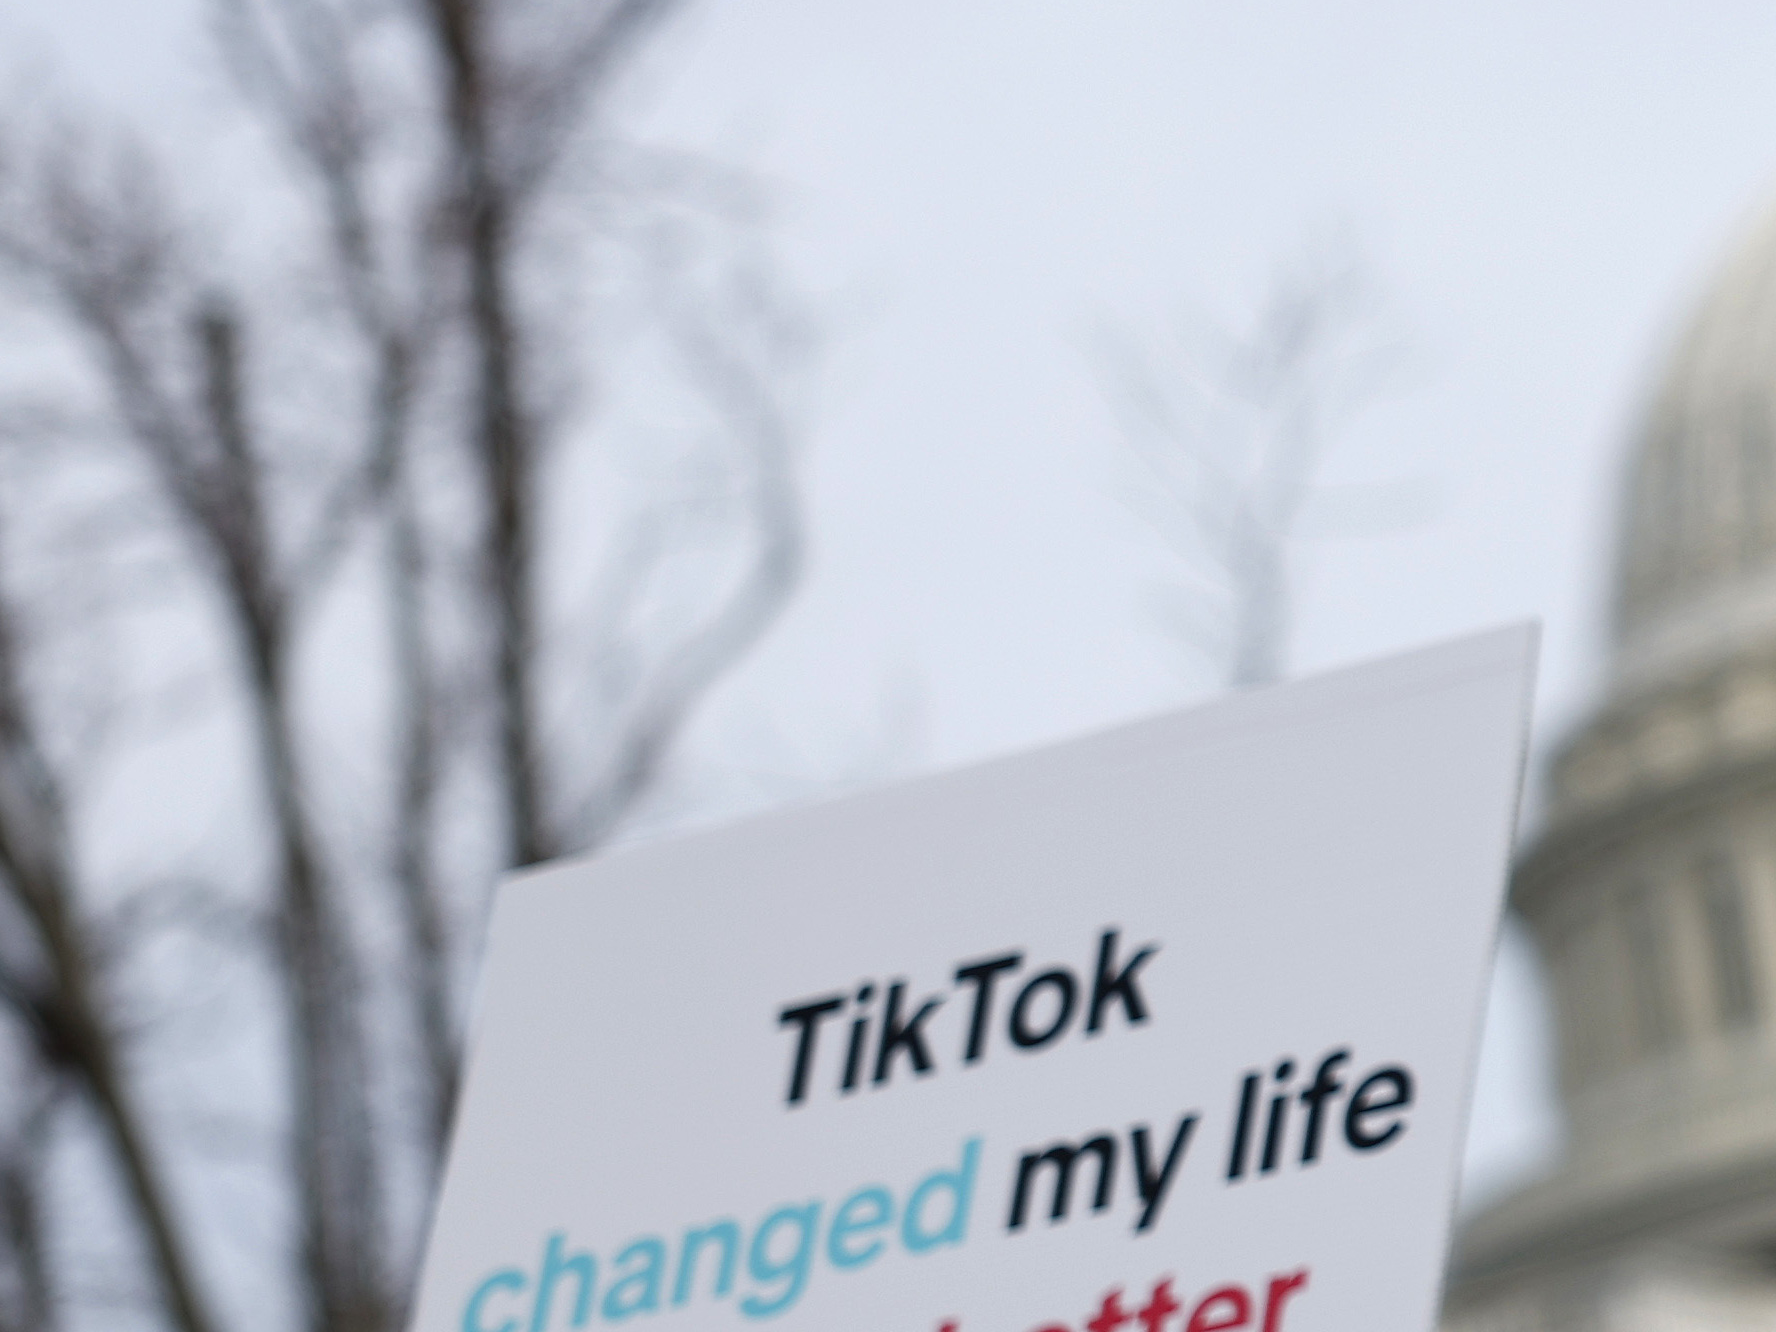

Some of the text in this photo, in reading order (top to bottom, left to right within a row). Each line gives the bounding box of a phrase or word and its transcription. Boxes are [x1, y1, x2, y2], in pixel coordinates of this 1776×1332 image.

[775, 926, 1159, 1110] TikTok
[1004, 1111, 1201, 1237] my
[1223, 1046, 1416, 1185] life
